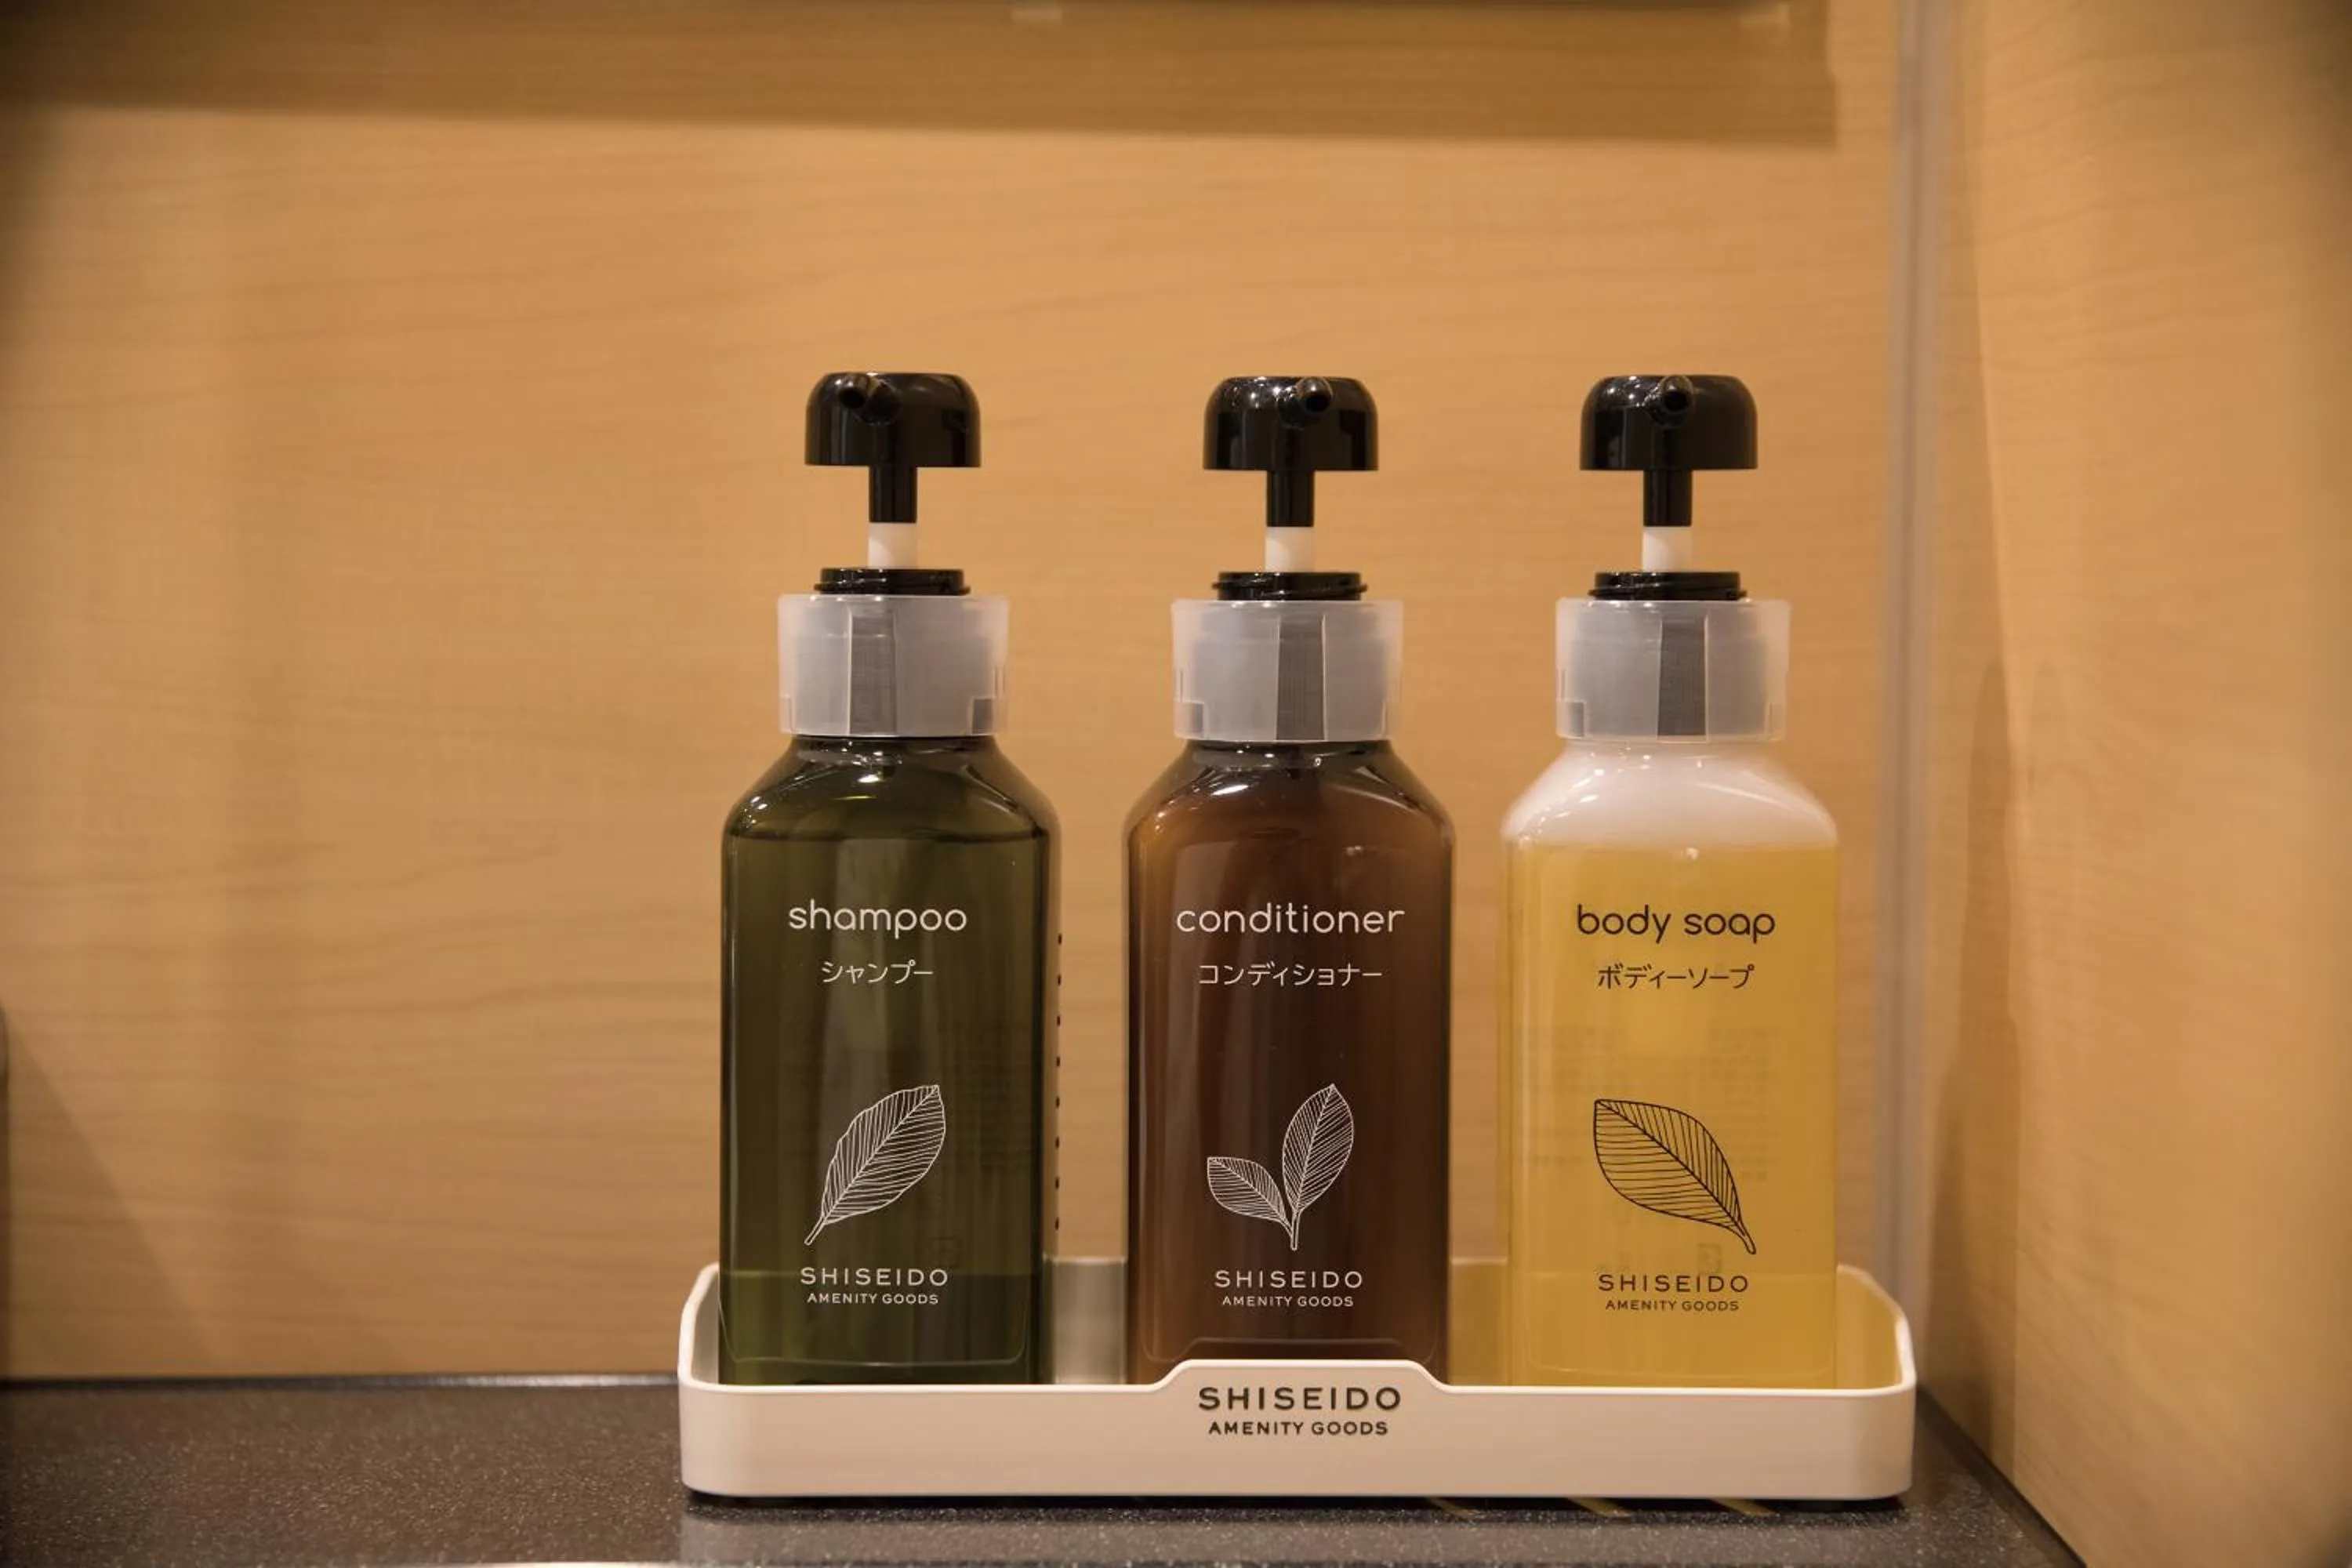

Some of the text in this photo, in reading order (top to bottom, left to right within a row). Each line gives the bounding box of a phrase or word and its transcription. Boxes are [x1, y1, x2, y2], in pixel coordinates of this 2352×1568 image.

[789, 898, 967, 938] shampoo
[1176, 902, 1406, 934] conditioner
[1577, 904, 1776, 943] body soap
[821, 959, 934, 984] シャンプー
[1199, 961, 1383, 987] コンディショナー
[1597, 964, 1755, 989] ボディーソープ
[800, 1266, 949, 1287] SHISEIDO
[1214, 1269, 1363, 1289] SHISEIDO
[1598, 1273, 1750, 1293] SHISEIDO
[807, 1293, 939, 1305] AMENITY GOODS
[1221, 1295, 1354, 1307] AMENITY GOODS
[1605, 1299, 1740, 1312] AMENITY GOODS
[1198, 1386, 1402, 1411] SHISEIDO
[1208, 1421, 1389, 1436] AMENITY GOODS
